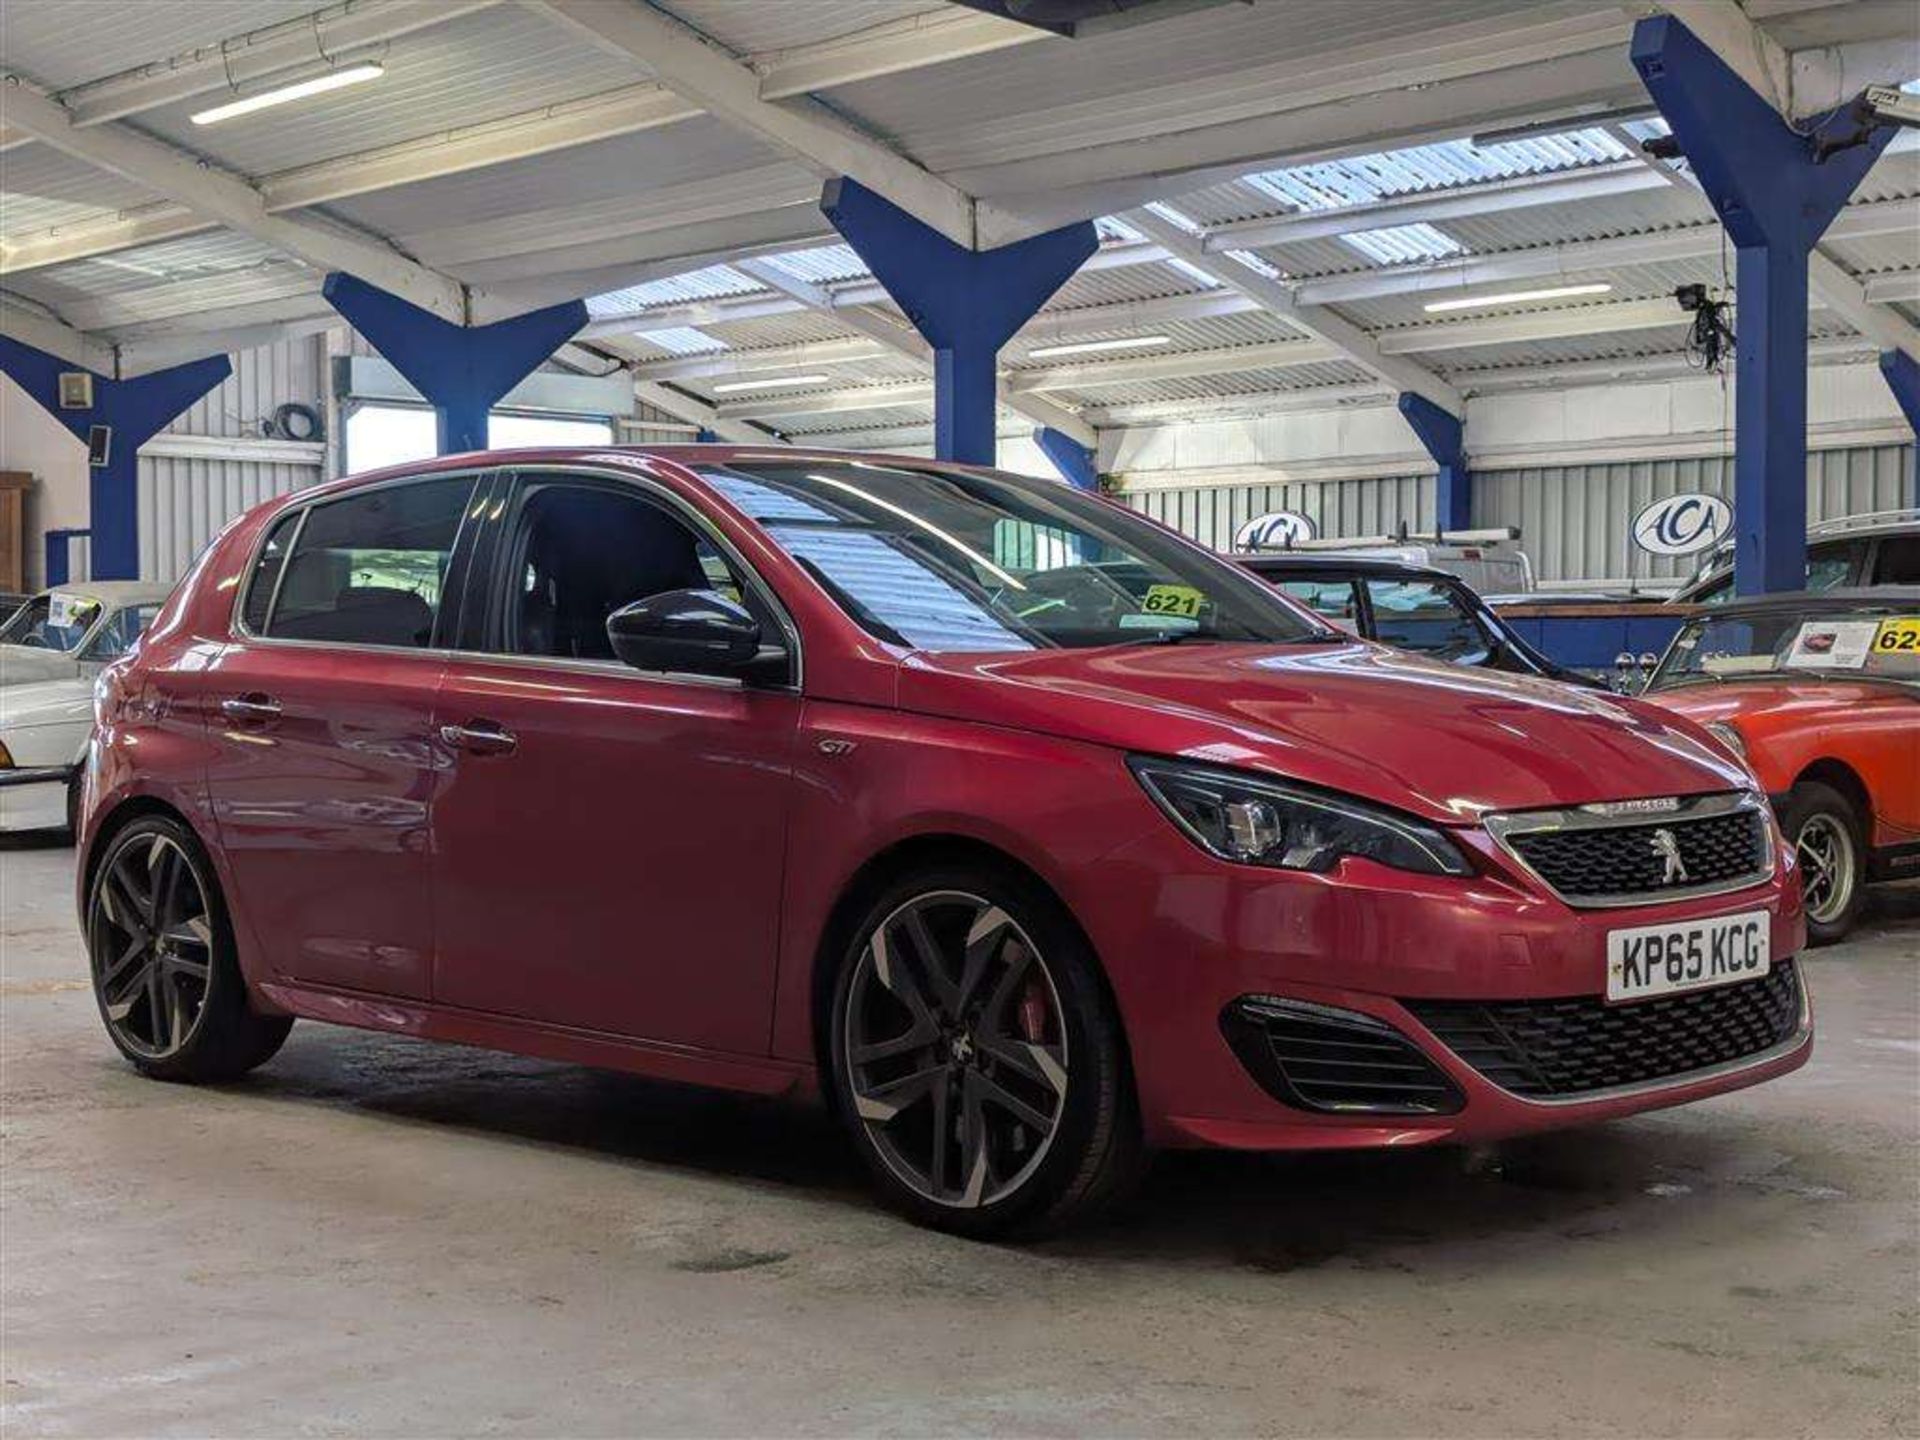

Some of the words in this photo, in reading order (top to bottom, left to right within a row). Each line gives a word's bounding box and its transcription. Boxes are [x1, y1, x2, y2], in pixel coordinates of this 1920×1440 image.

[1638, 499, 1717, 547] ACA
[1145, 593, 1196, 615] 621
[1880, 630, 1920, 650] 62
[1623, 931, 1703, 988] KP65
[1711, 922, 1758, 976] KCG
